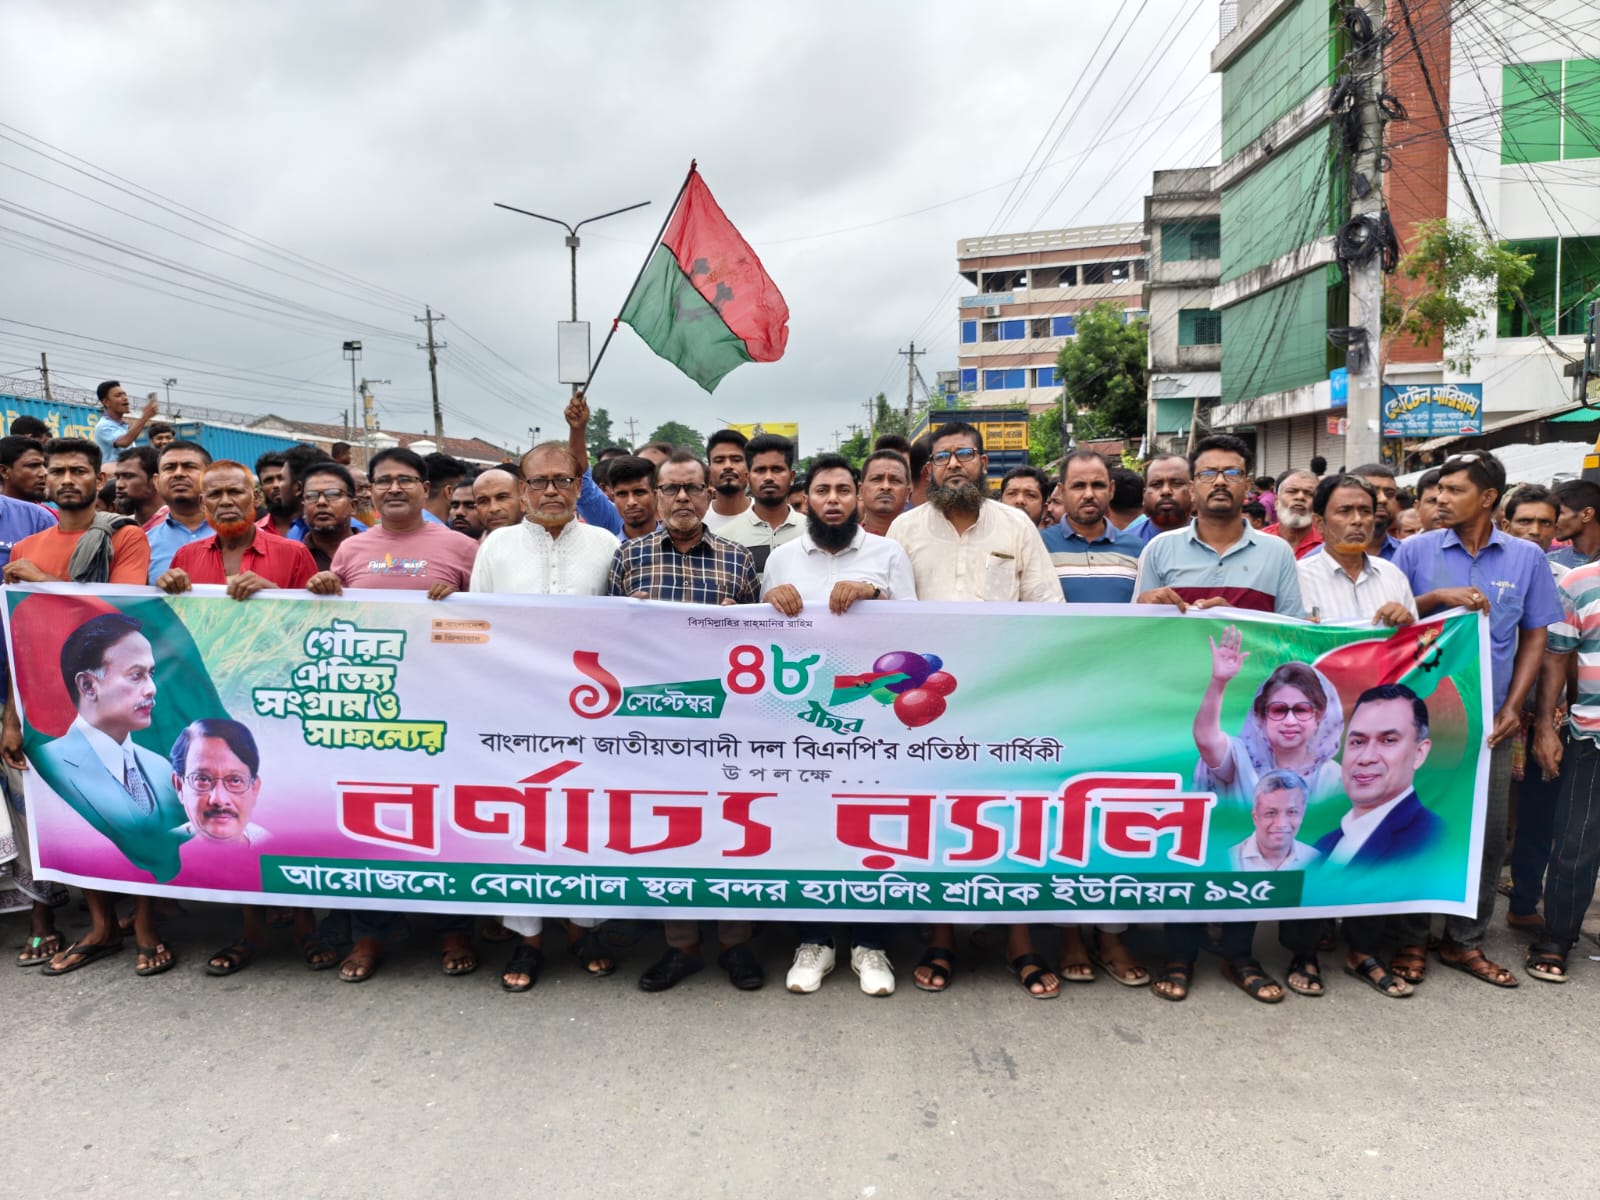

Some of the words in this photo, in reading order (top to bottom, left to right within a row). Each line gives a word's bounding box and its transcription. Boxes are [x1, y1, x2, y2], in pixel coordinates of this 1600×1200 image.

[305, 620, 406, 662] গৌরব
[293, 657, 396, 694] ঐতিহ্য
[569, 650, 622, 719] ১
[626, 688, 716, 714] সেপ্টেম্বর
[727, 644, 820, 695] ৪৮
[253, 689, 368, 719] সংগ্রাম
[374, 692, 401, 720] ও
[303, 719, 446, 755] সাফল্যের
[479, 733, 586, 754] বাংলাদেশ
[593, 731, 741, 758] জাতীয়তাবাদী
[750, 741, 786, 760] দল
[907, 736, 980, 762] প্রতিষ্ঠা
[987, 737, 1064, 763] বার্ষিকী
[337, 759, 777, 857] বর্ণাঢ্য
[279, 865, 456, 895] আয়োজনে:
[471, 871, 630, 900] বেনাপোল
[637, 876, 696, 903] স্থল
[704, 878, 789, 902] বন্দর
[797, 872, 932, 905] হ্যান্ডলিং
[941, 874, 1042, 906] শ্রমিক
[1050, 874, 1195, 906] ইউনিয়ন
[1204, 879, 1276, 905] ৯২৫
